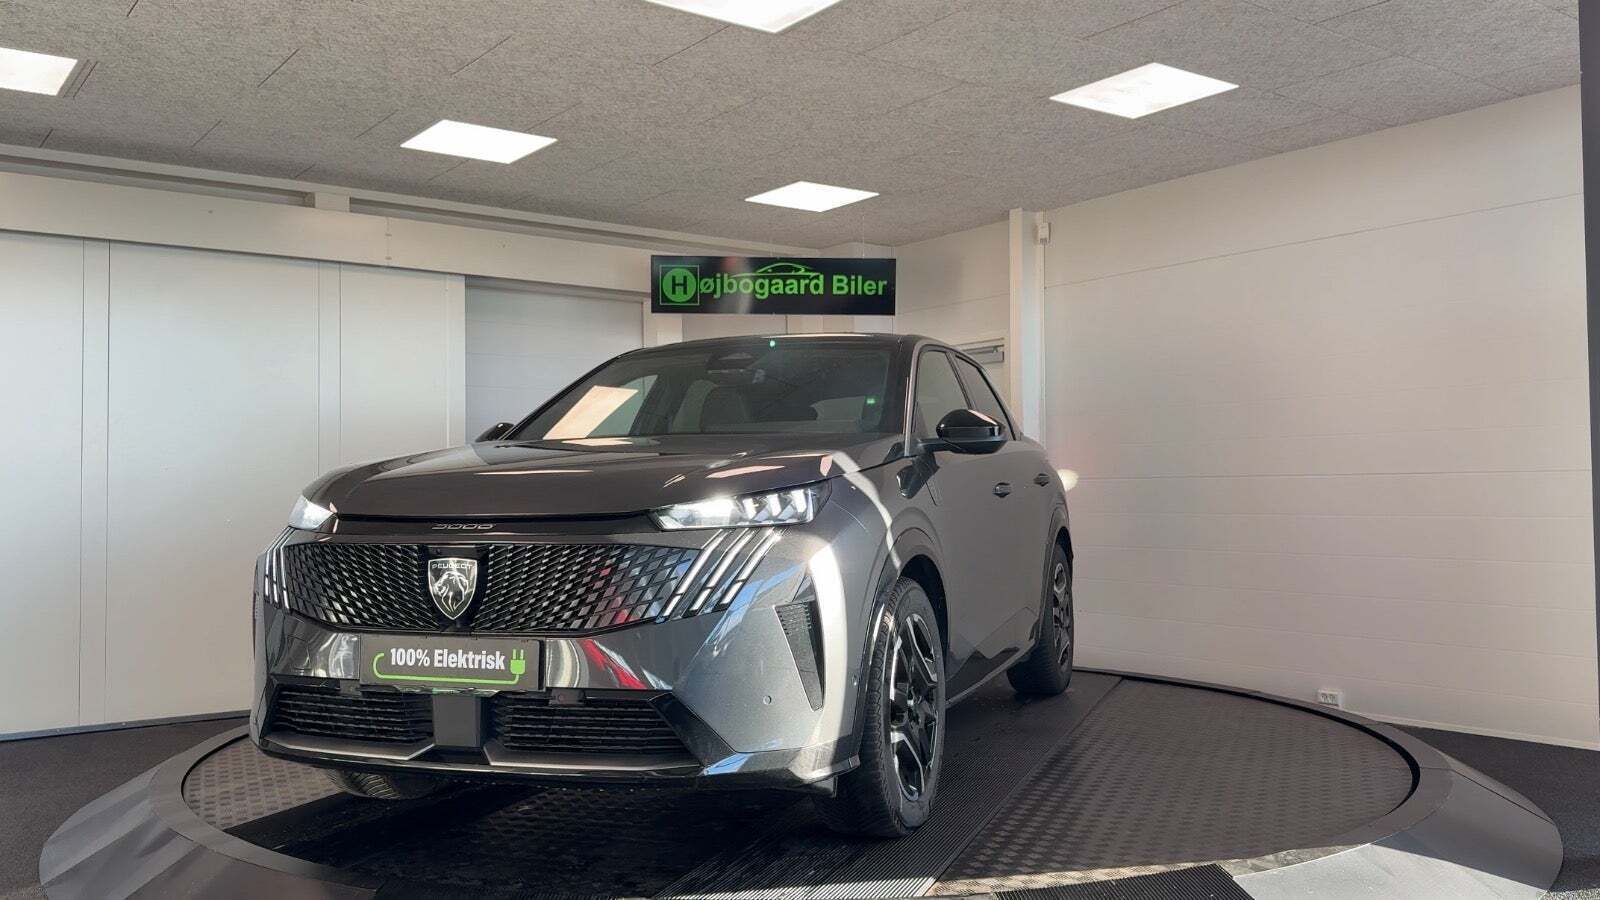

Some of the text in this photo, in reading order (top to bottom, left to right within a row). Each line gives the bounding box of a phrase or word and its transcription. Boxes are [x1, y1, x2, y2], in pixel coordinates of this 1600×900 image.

[664, 271, 888, 300] Højbogaard Biler
[390, 648, 505, 670] 100% Elektrisk
